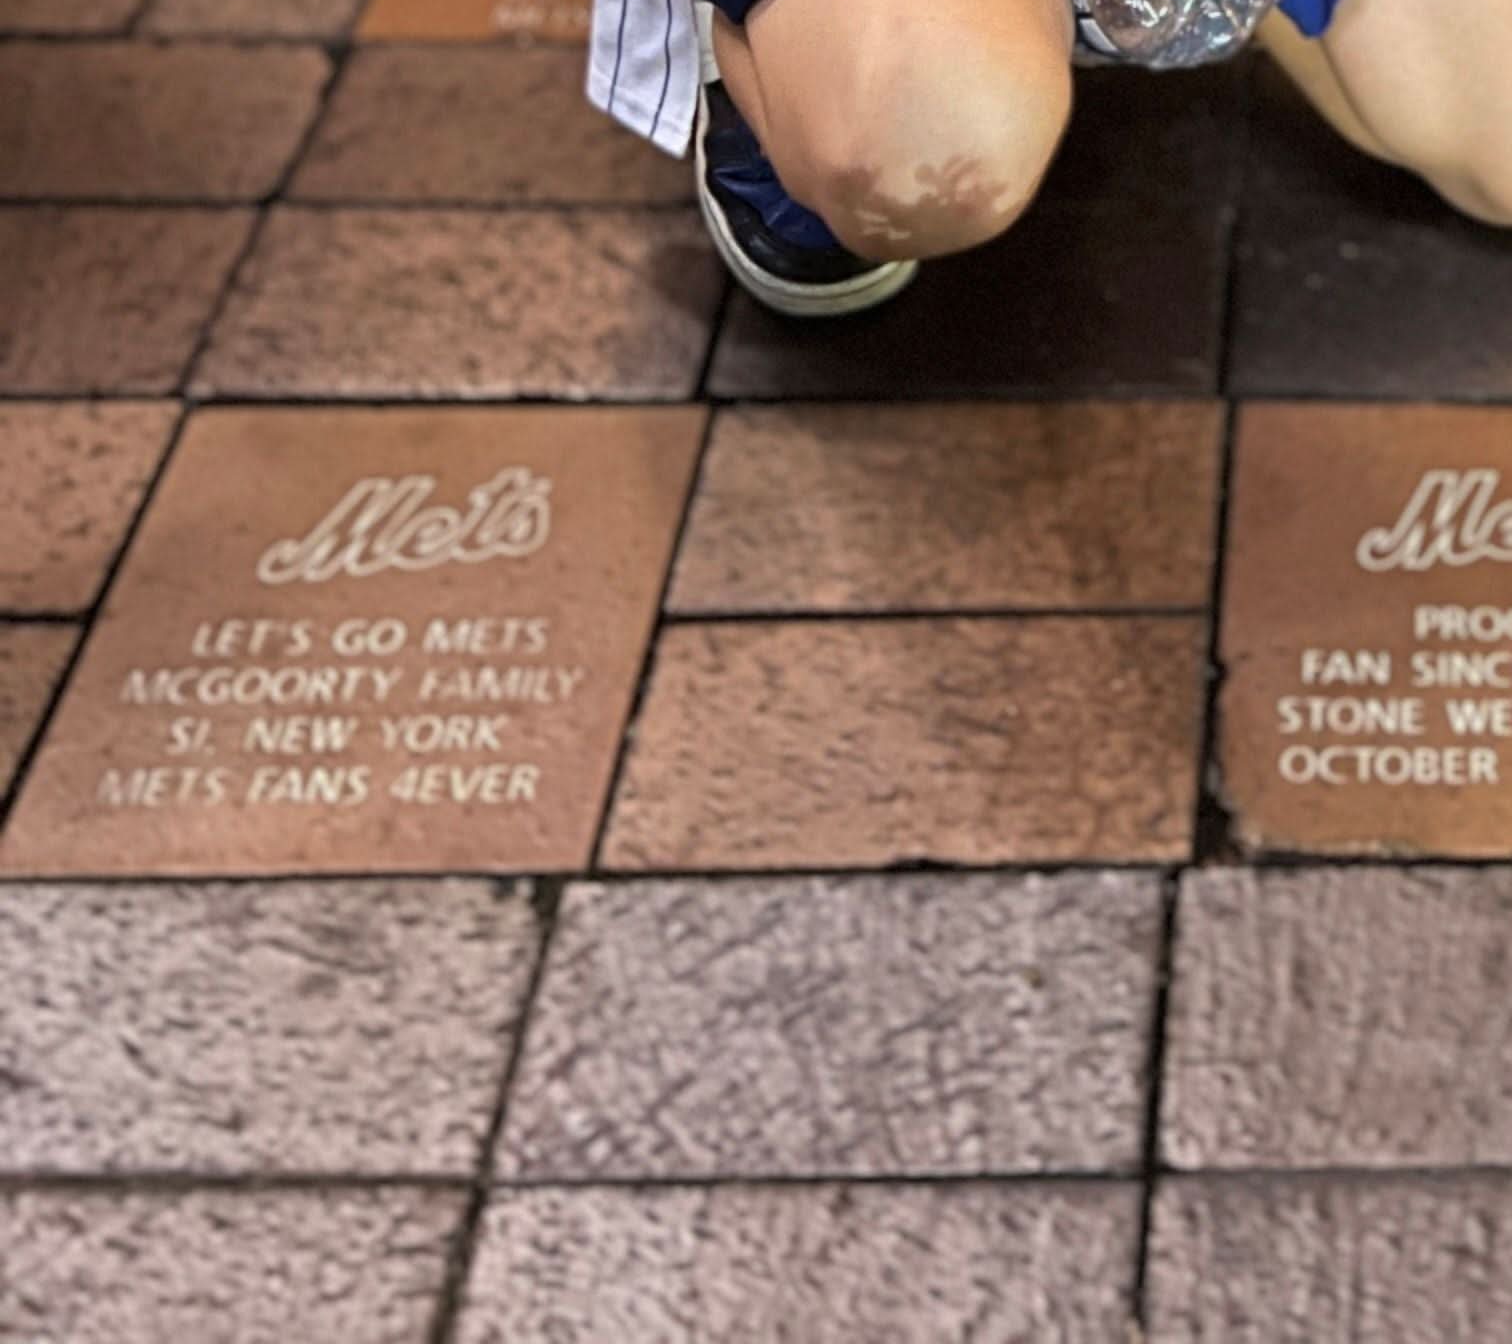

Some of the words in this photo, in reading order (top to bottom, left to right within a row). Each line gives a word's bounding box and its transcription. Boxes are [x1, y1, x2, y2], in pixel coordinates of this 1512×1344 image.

[255, 464, 555, 586] Mets
[191, 619, 313, 657] LET'S
[331, 619, 407, 656] GO
[423, 618, 546, 655] METS
[121, 666, 404, 706] MCGOORTY
[418, 666, 583, 704] FAMILY
[1301, 649, 1391, 685] FAN
[244, 716, 357, 754] NEW
[381, 715, 509, 752] YORK
[1278, 697, 1422, 736] STONE
[1279, 745, 1499, 785] OCTOBER
[96, 766, 231, 807] METS
[247, 765, 370, 805] FANS
[389, 764, 541, 804] 4EVER
